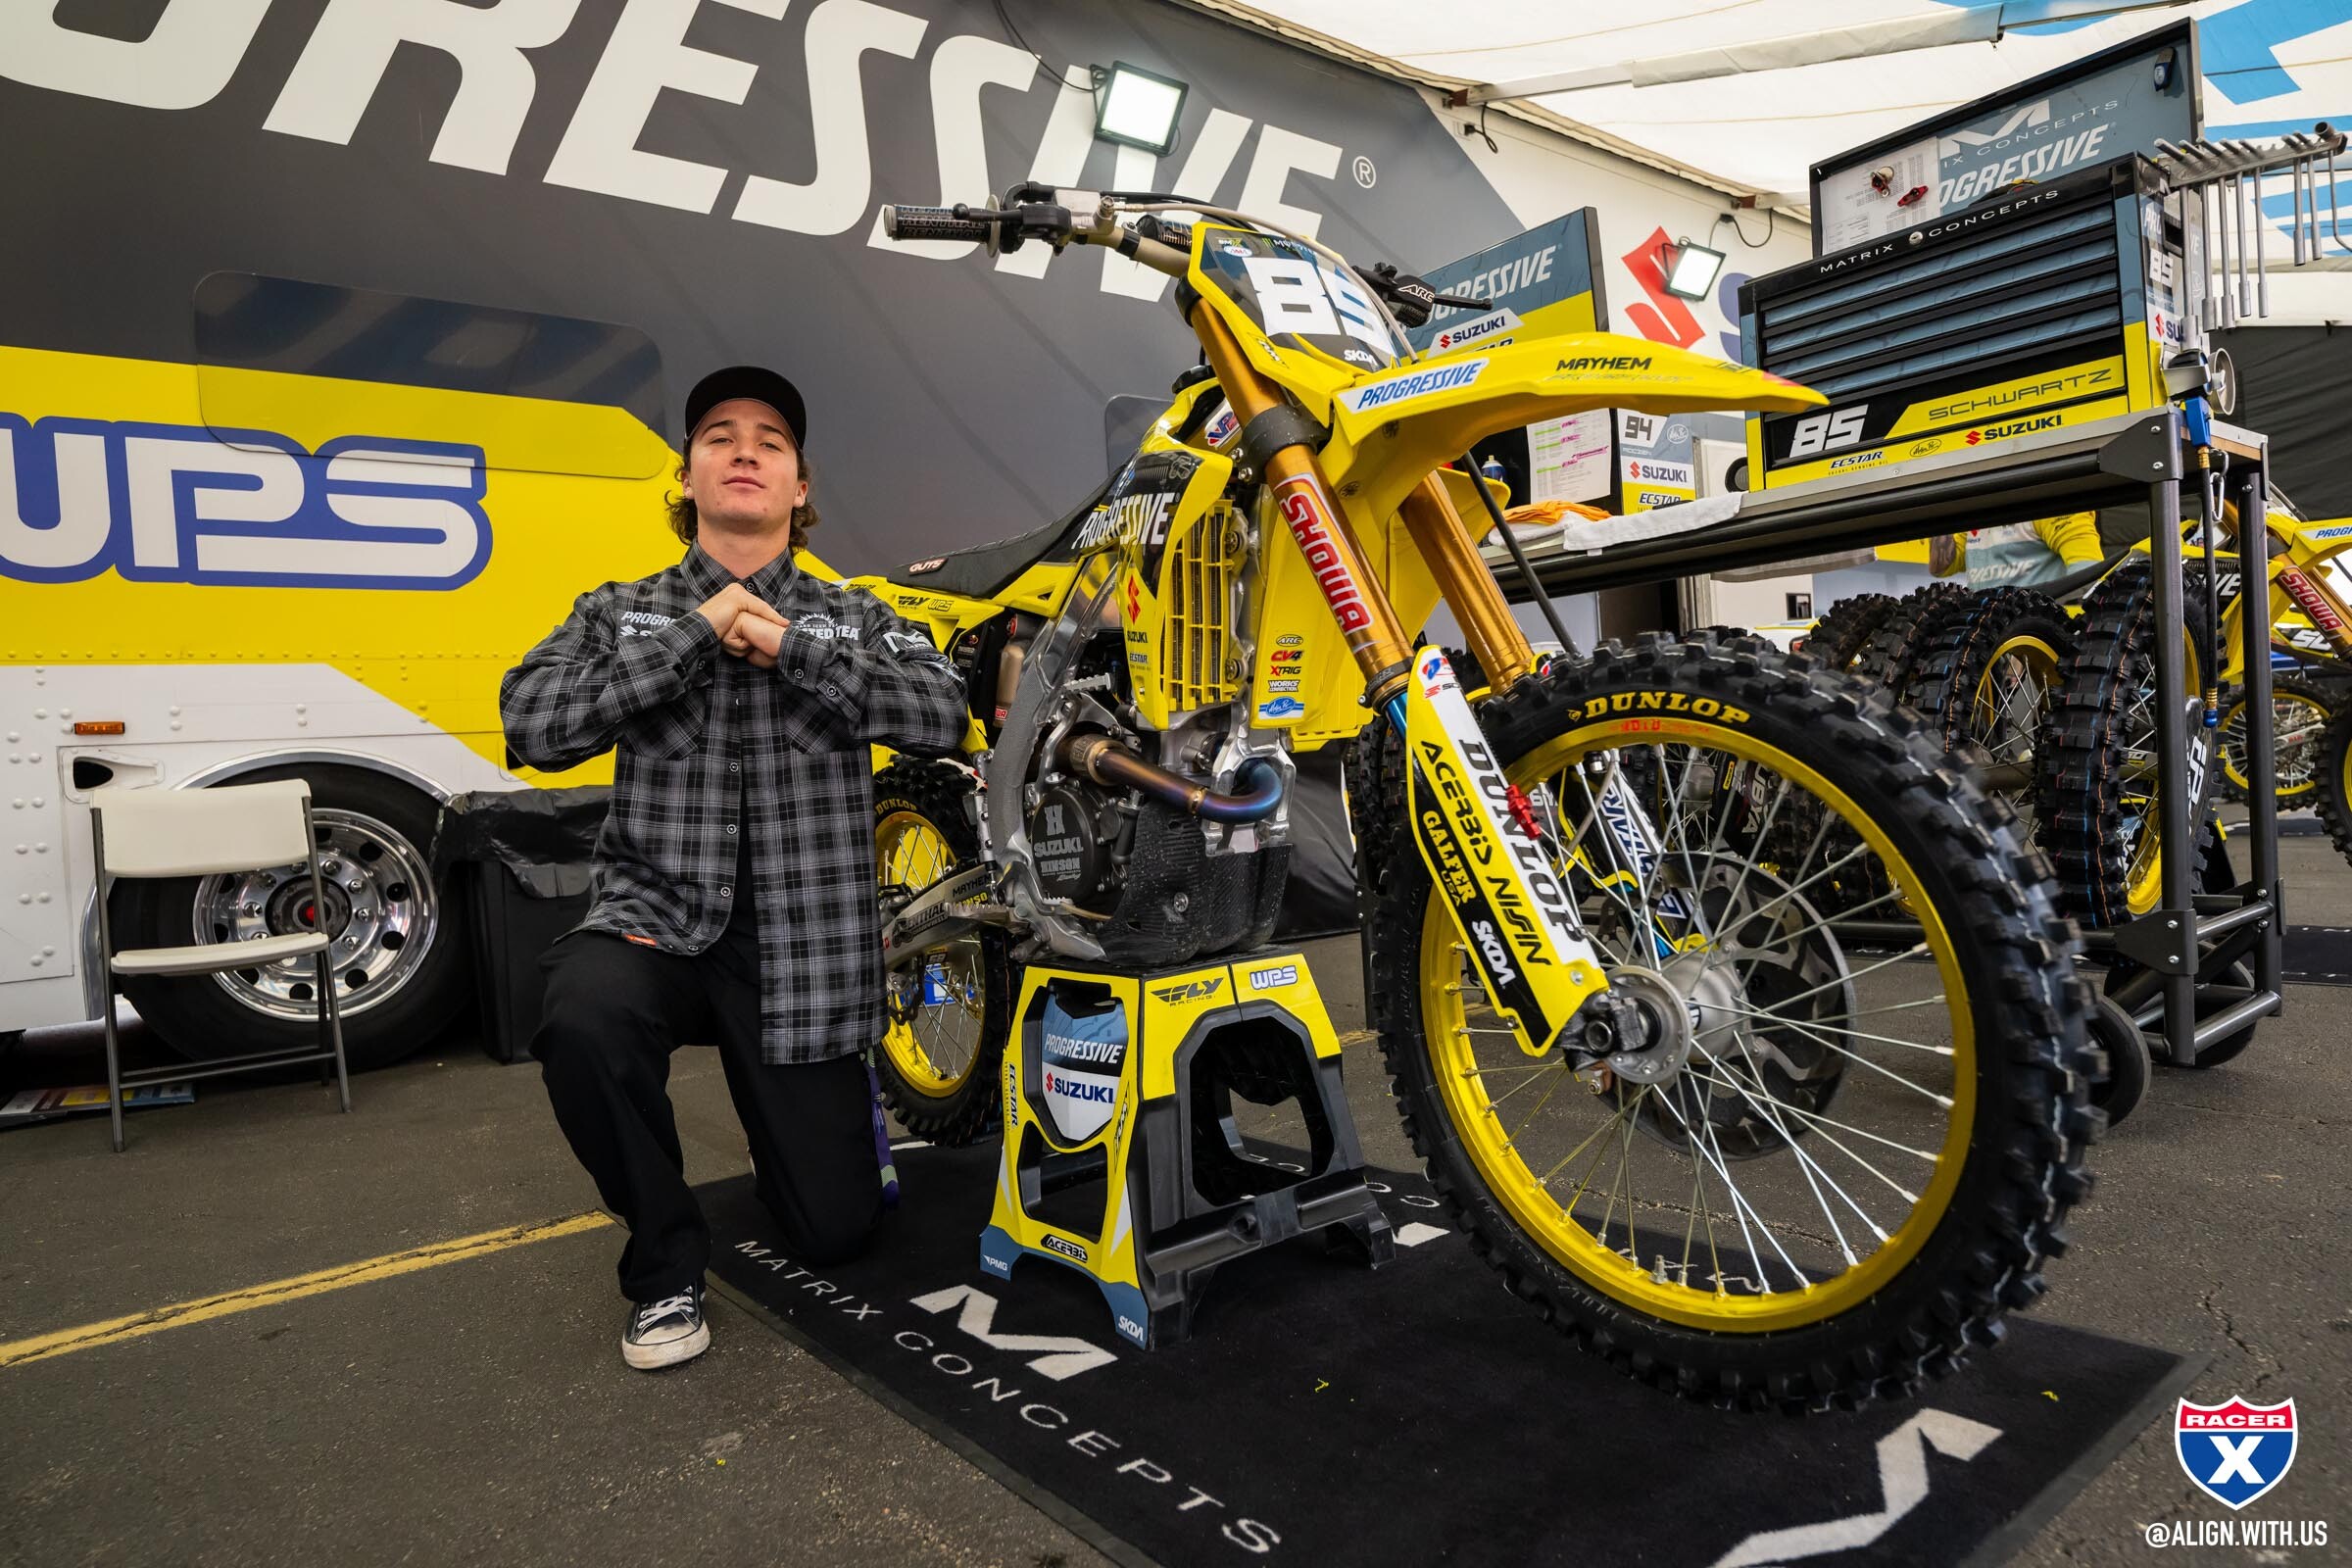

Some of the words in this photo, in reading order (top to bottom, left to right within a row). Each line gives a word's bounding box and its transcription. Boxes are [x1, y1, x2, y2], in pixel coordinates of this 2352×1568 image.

[1977, 100, 2119, 156] CONCEPTS
[1938, 124, 2109, 209] OGRESSIVE
[1820, 243, 1893, 273] MATRIX
[1928, 189, 2059, 238] CONCEPTS
[1397, 283, 1436, 304] ARC
[1409, 245, 1556, 329] GRESSIVE
[1452, 315, 1505, 344] SUZUKI
[1556, 357, 1653, 371] MAYHEM
[1357, 363, 1483, 410] PROGRESSIVE
[1929, 368, 2113, 421] SCHWARTZ
[1625, 415, 1653, 441] 94
[1789, 404, 1869, 459] 85
[1984, 415, 2064, 441] SUZUKI
[1642, 465, 1688, 483] SUZUKI
[1831, 451, 1884, 469] ECSTAR
[909, 558, 946, 572] GUTS
[1279, 491, 1374, 636] SHOWA
[2280, 573, 2343, 632] SHOWA
[835, 624, 860, 641] TEA
[1277, 636, 1302, 645] ARC
[1270, 664, 1302, 676] XTRIG
[1271, 650, 1304, 662] CV4
[1585, 691, 1751, 724] DUNLOP
[875, 798, 918, 815] DUNLOP
[1034, 836, 1084, 858] SUZUKI
[1458, 739, 1586, 943] DUNLOP
[1041, 857, 1081, 873] HINSON
[1422, 810, 1478, 905] GALFER
[1441, 869, 1461, 907] USA
[1472, 919, 1517, 986] SKDA
[1151, 978, 1224, 1001] FLY
[1250, 964, 1298, 990] WPS
[1170, 994, 1216, 1007] RACING
[1044, 1032, 1124, 1064] PROGRESSIVE
[1008, 1063, 1019, 1127] ECSTAR
[1054, 1077, 1115, 1104] SUZUKI
[989, 1258, 1008, 1272] PMG
[735, 1241, 884, 1322] MATRIX
[894, 1330, 1282, 1554] CONCEPTS
